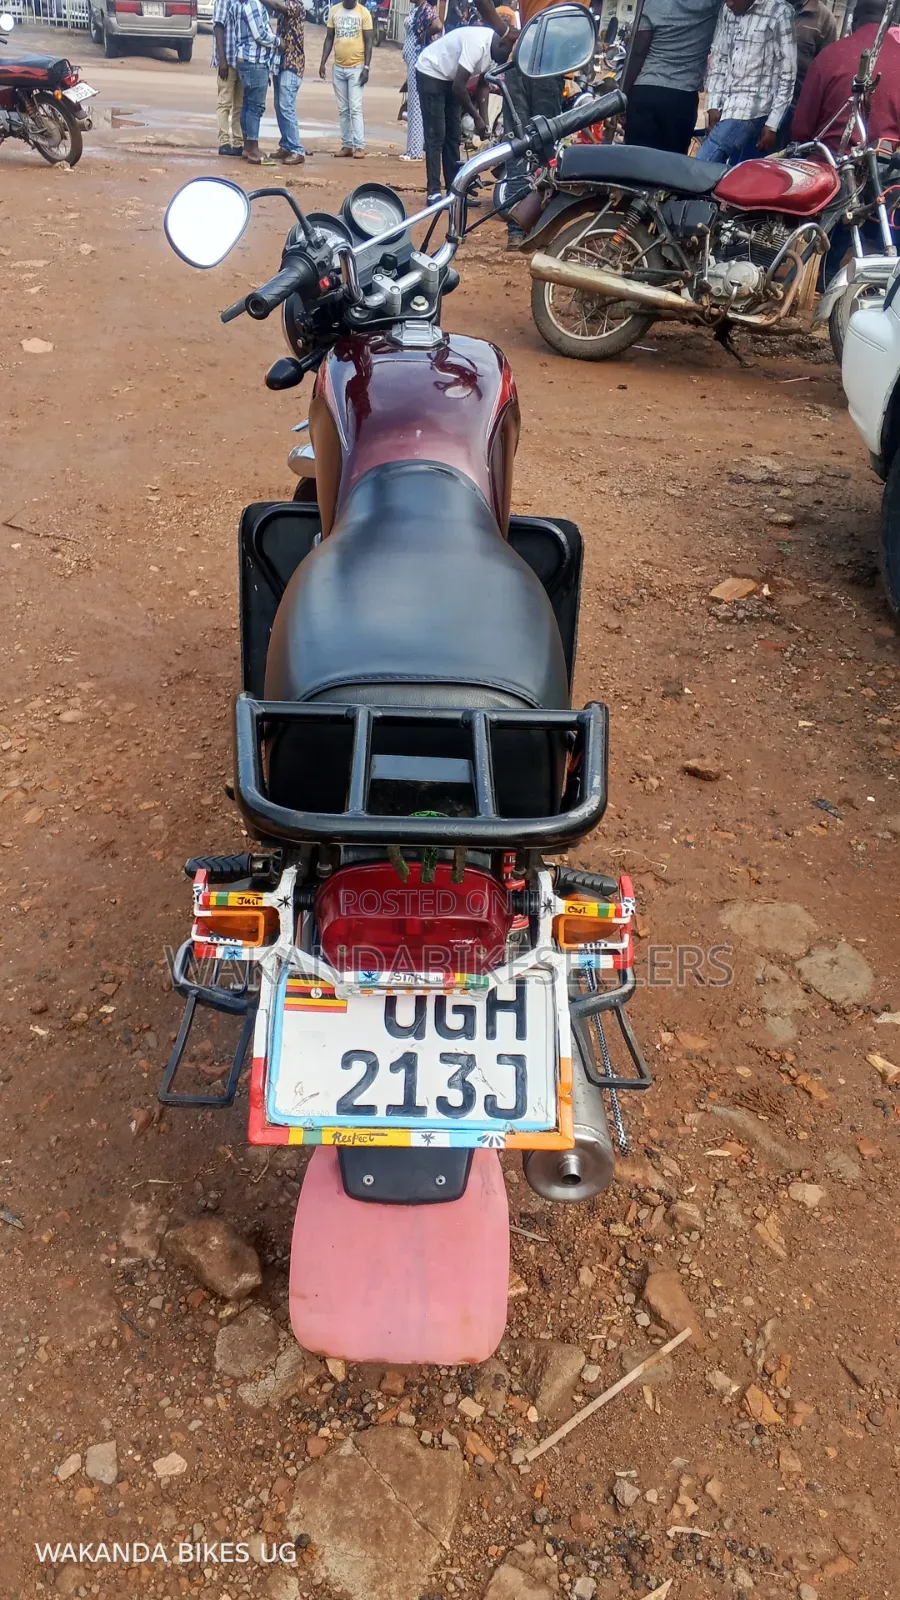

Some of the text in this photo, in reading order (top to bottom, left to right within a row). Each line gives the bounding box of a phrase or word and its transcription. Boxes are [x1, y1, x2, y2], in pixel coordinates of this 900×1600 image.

[384, 978, 527, 1041] UGH
[336, 1049, 527, 1120] 213J
[332, 1131, 388, 1145] Respect
